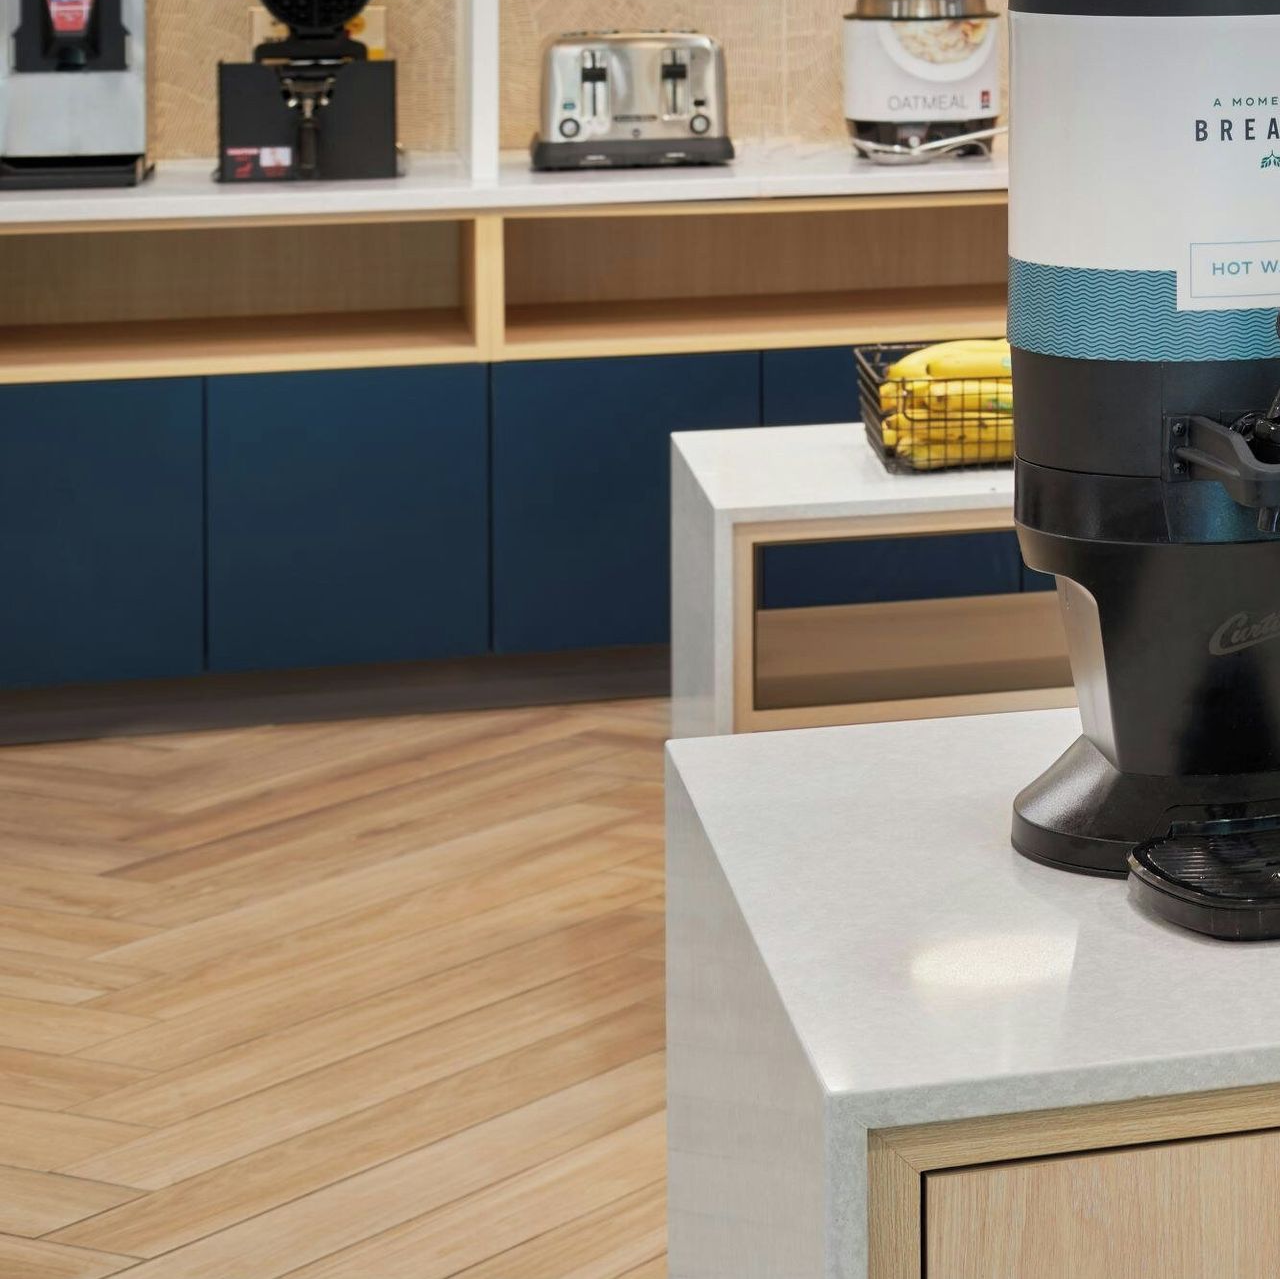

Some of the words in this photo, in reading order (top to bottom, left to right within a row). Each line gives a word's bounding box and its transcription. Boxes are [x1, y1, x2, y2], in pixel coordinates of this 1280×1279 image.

[887, 93, 968, 112] OATMEAL
[1213, 97, 1222, 107] A
[1212, 261, 1254, 276] HOT
